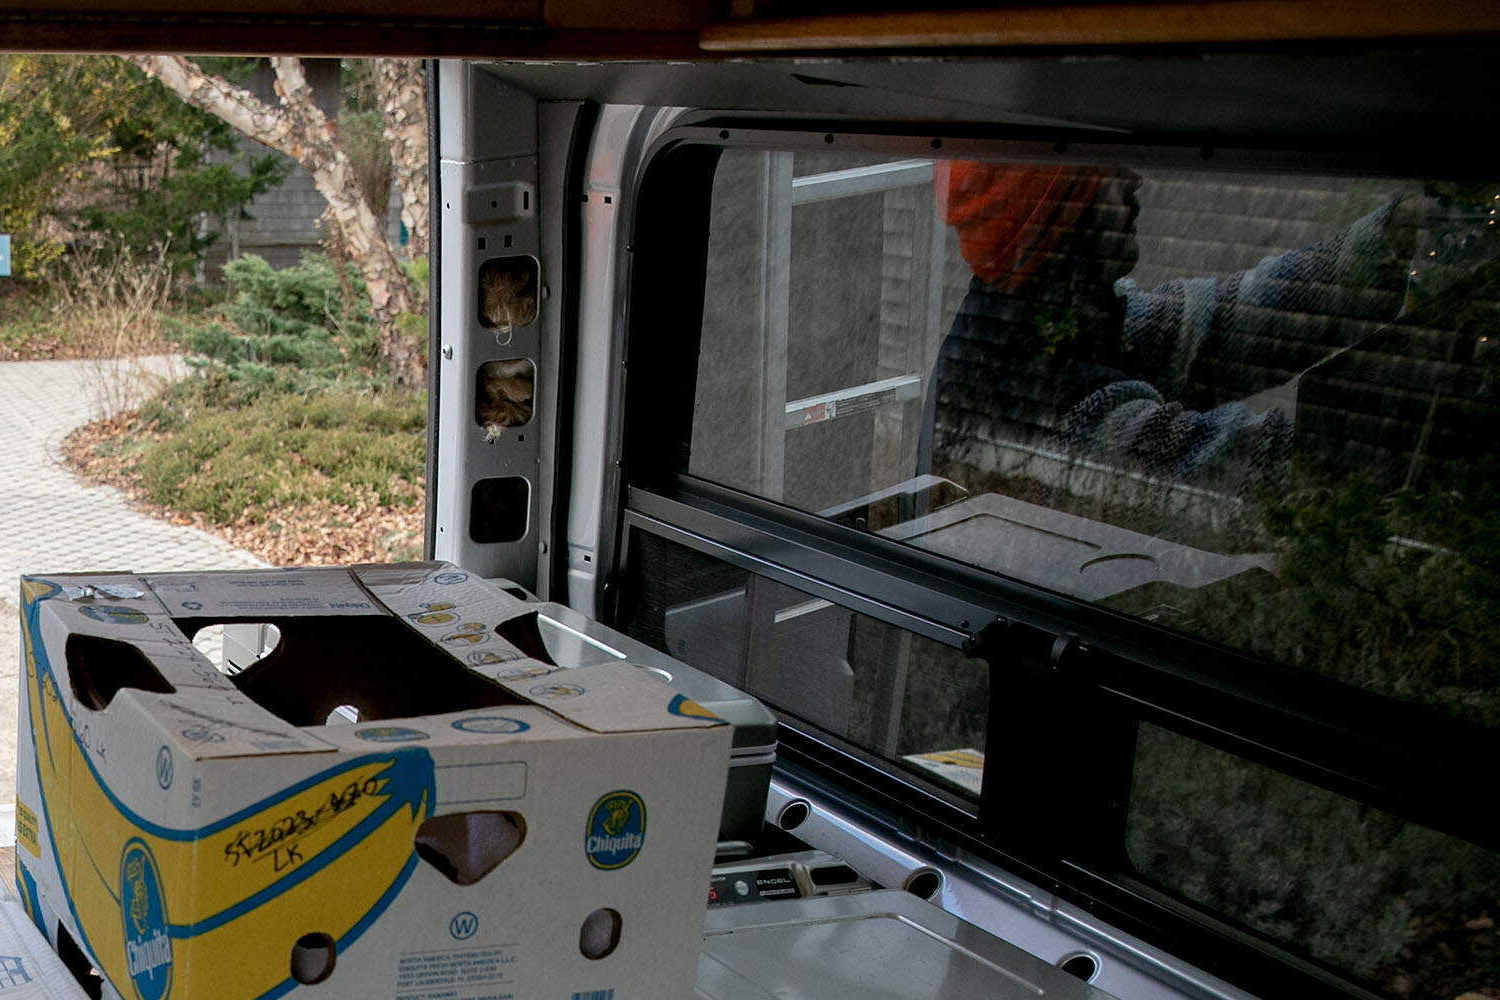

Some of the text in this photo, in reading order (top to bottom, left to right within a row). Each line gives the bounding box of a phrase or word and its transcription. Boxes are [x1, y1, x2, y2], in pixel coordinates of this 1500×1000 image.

[274, 844, 303, 872] LK
[585, 829, 644, 859] Chiquita
[123, 929, 174, 982] Chiquita
